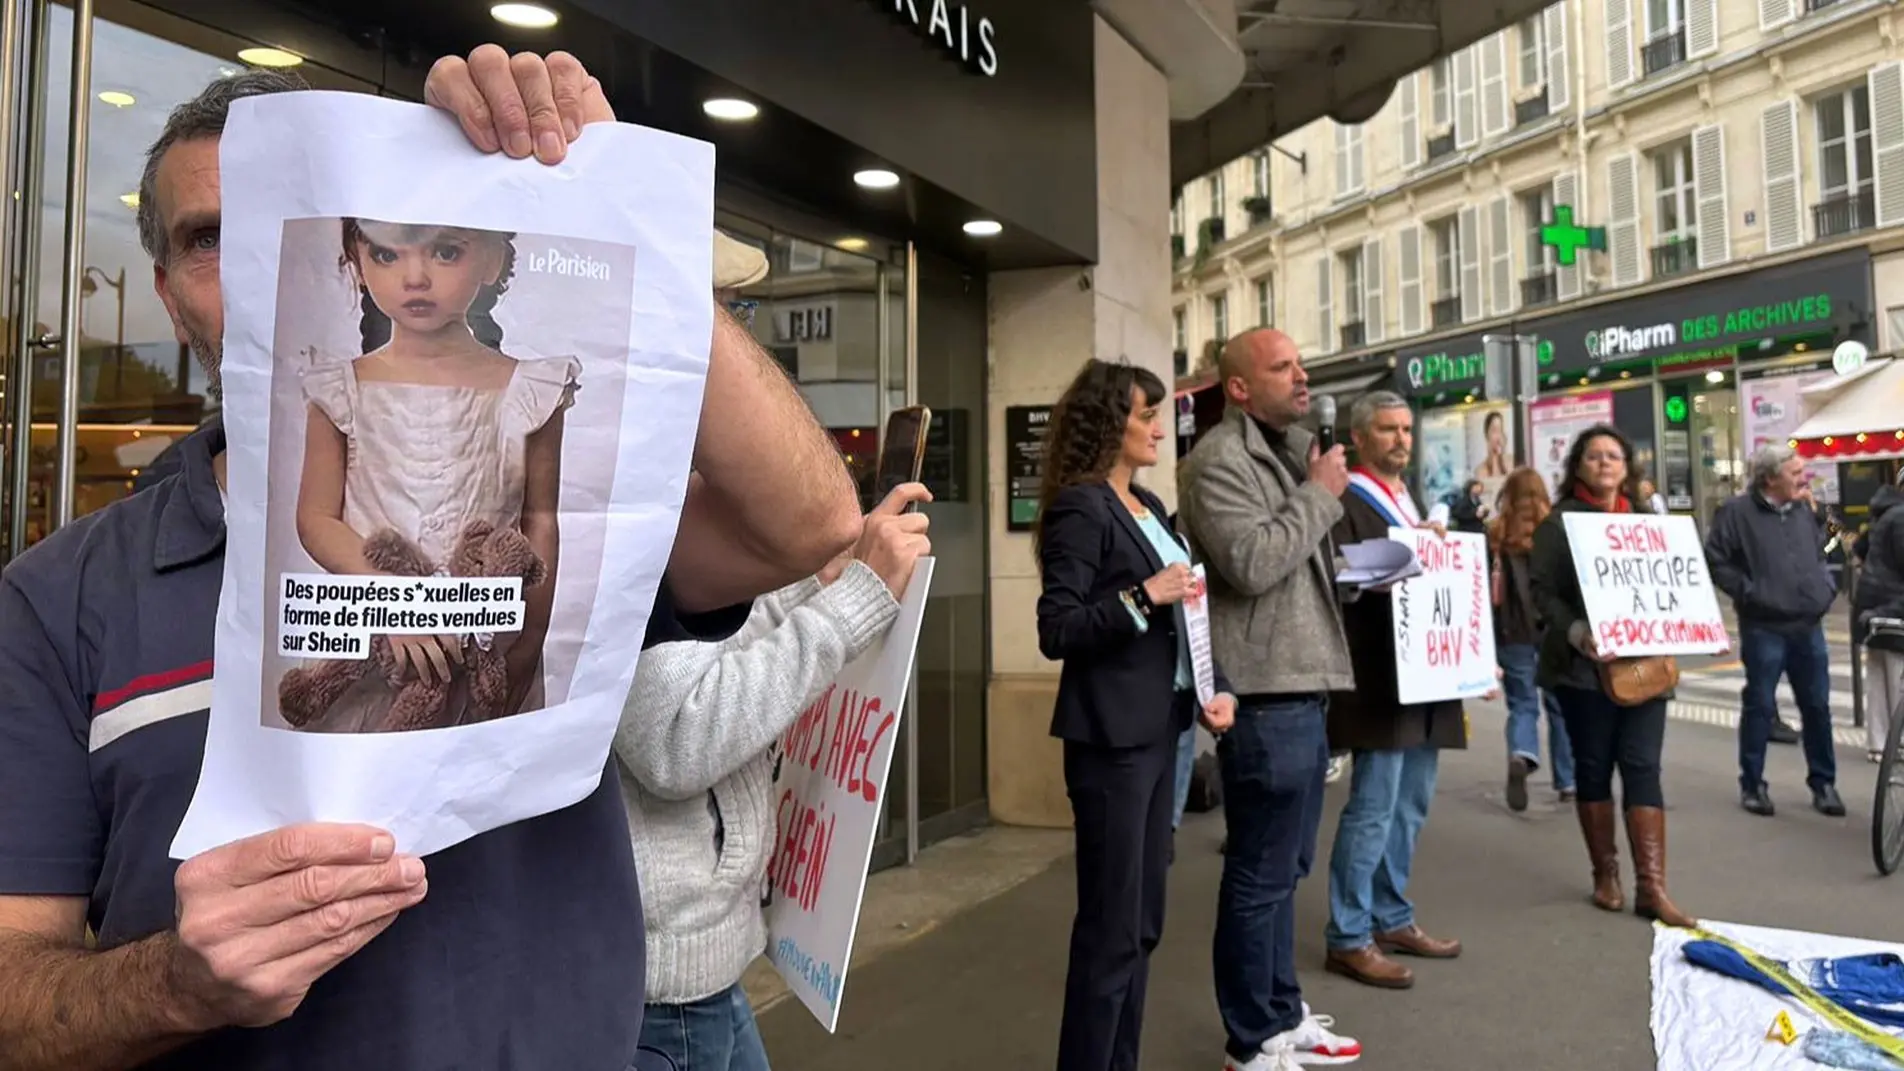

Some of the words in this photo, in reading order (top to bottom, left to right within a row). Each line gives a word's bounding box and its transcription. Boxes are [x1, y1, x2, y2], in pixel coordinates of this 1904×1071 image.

[895, 0, 997, 77] AIS
[528, 252, 546, 272] Le
[547, 248, 610, 281] Parisien
[1599, 323, 1676, 356] iPharm
[1682, 315, 1719, 343] DES
[1724, 294, 1832, 333] ARCHIVES
[1417, 534, 1463, 572] HONTE
[1595, 554, 1701, 587] PARTICIPE
[286, 579, 314, 600] Des
[316, 581, 400, 605] poupées
[493, 586, 514, 601] en
[1433, 587, 1451, 627] AU
[1632, 587, 1648, 613] À
[1656, 591, 1679, 612] LA
[284, 604, 331, 626] forme
[334, 606, 358, 627] de
[362, 607, 438, 628] fillettes
[442, 607, 517, 628] vendues
[283, 634, 305, 651] sur
[308, 632, 360, 653] Shein
[1426, 626, 1463, 667] BHV
[824, 688, 895, 802] AVEC
